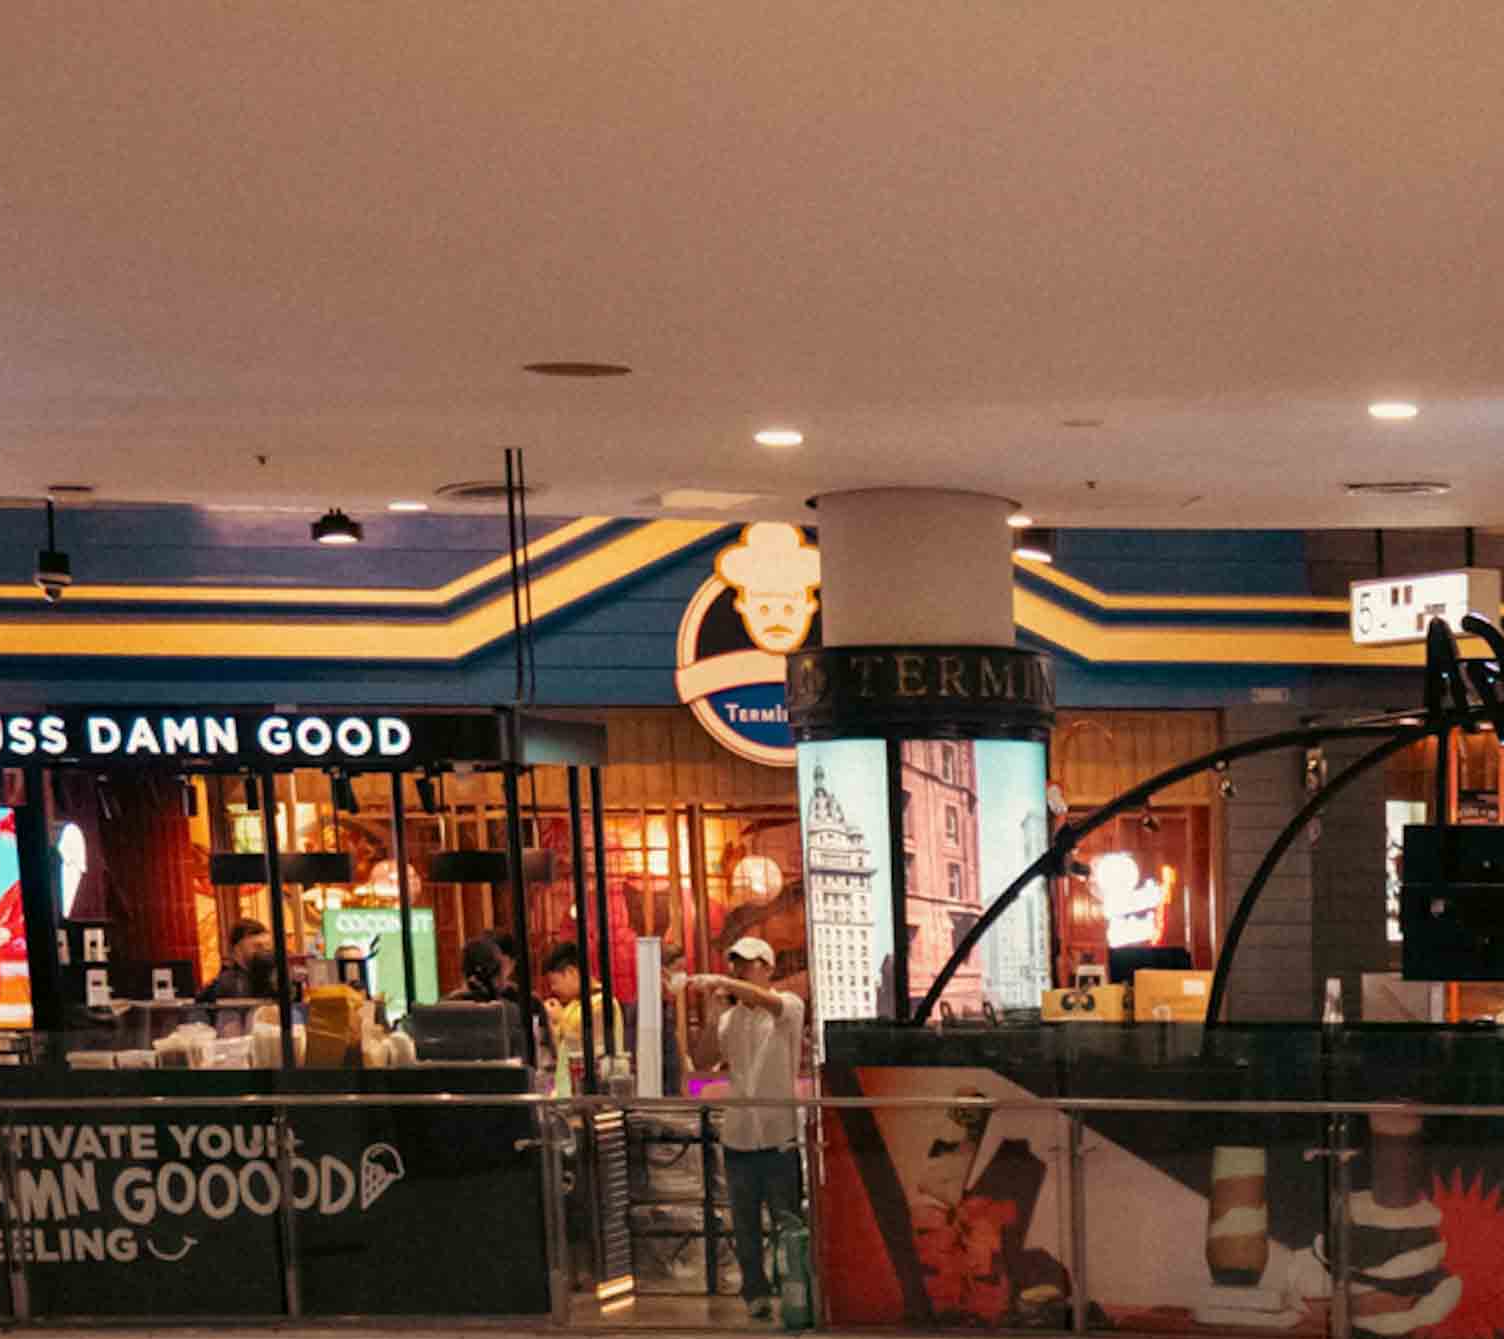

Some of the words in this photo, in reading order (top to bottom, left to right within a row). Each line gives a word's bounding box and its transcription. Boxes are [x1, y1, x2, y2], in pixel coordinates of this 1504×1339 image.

[88, 716, 238, 757] DAMN
[257, 716, 413, 758] GOOD
[169, 1125, 301, 1160] YOUR
